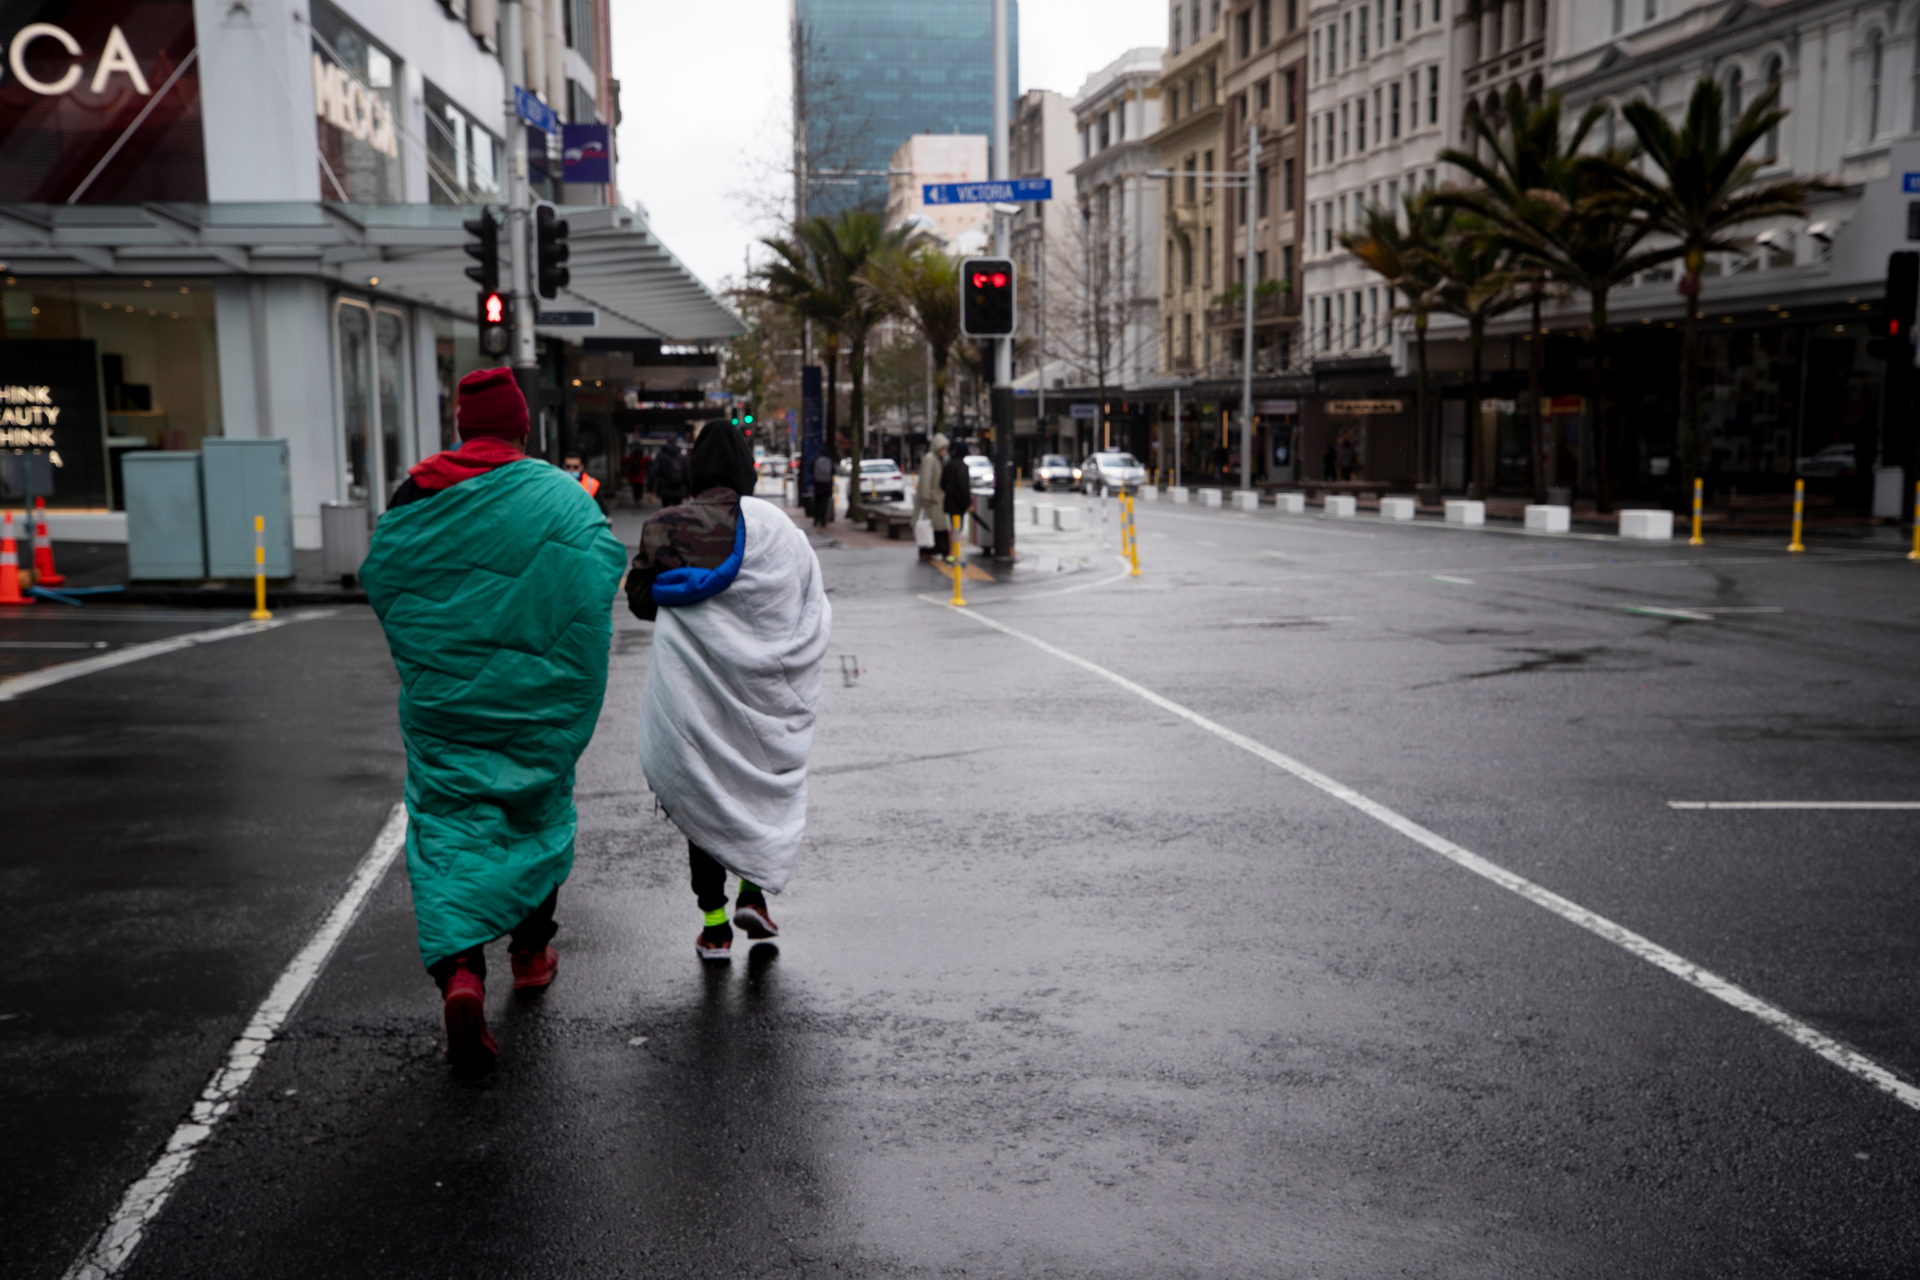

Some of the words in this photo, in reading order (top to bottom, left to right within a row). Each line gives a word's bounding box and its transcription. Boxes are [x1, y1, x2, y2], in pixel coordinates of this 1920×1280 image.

[0, 22, 151, 95] CA
[956, 184, 1014, 202] VICTORIA
[0, 406, 60, 426] AUTY
